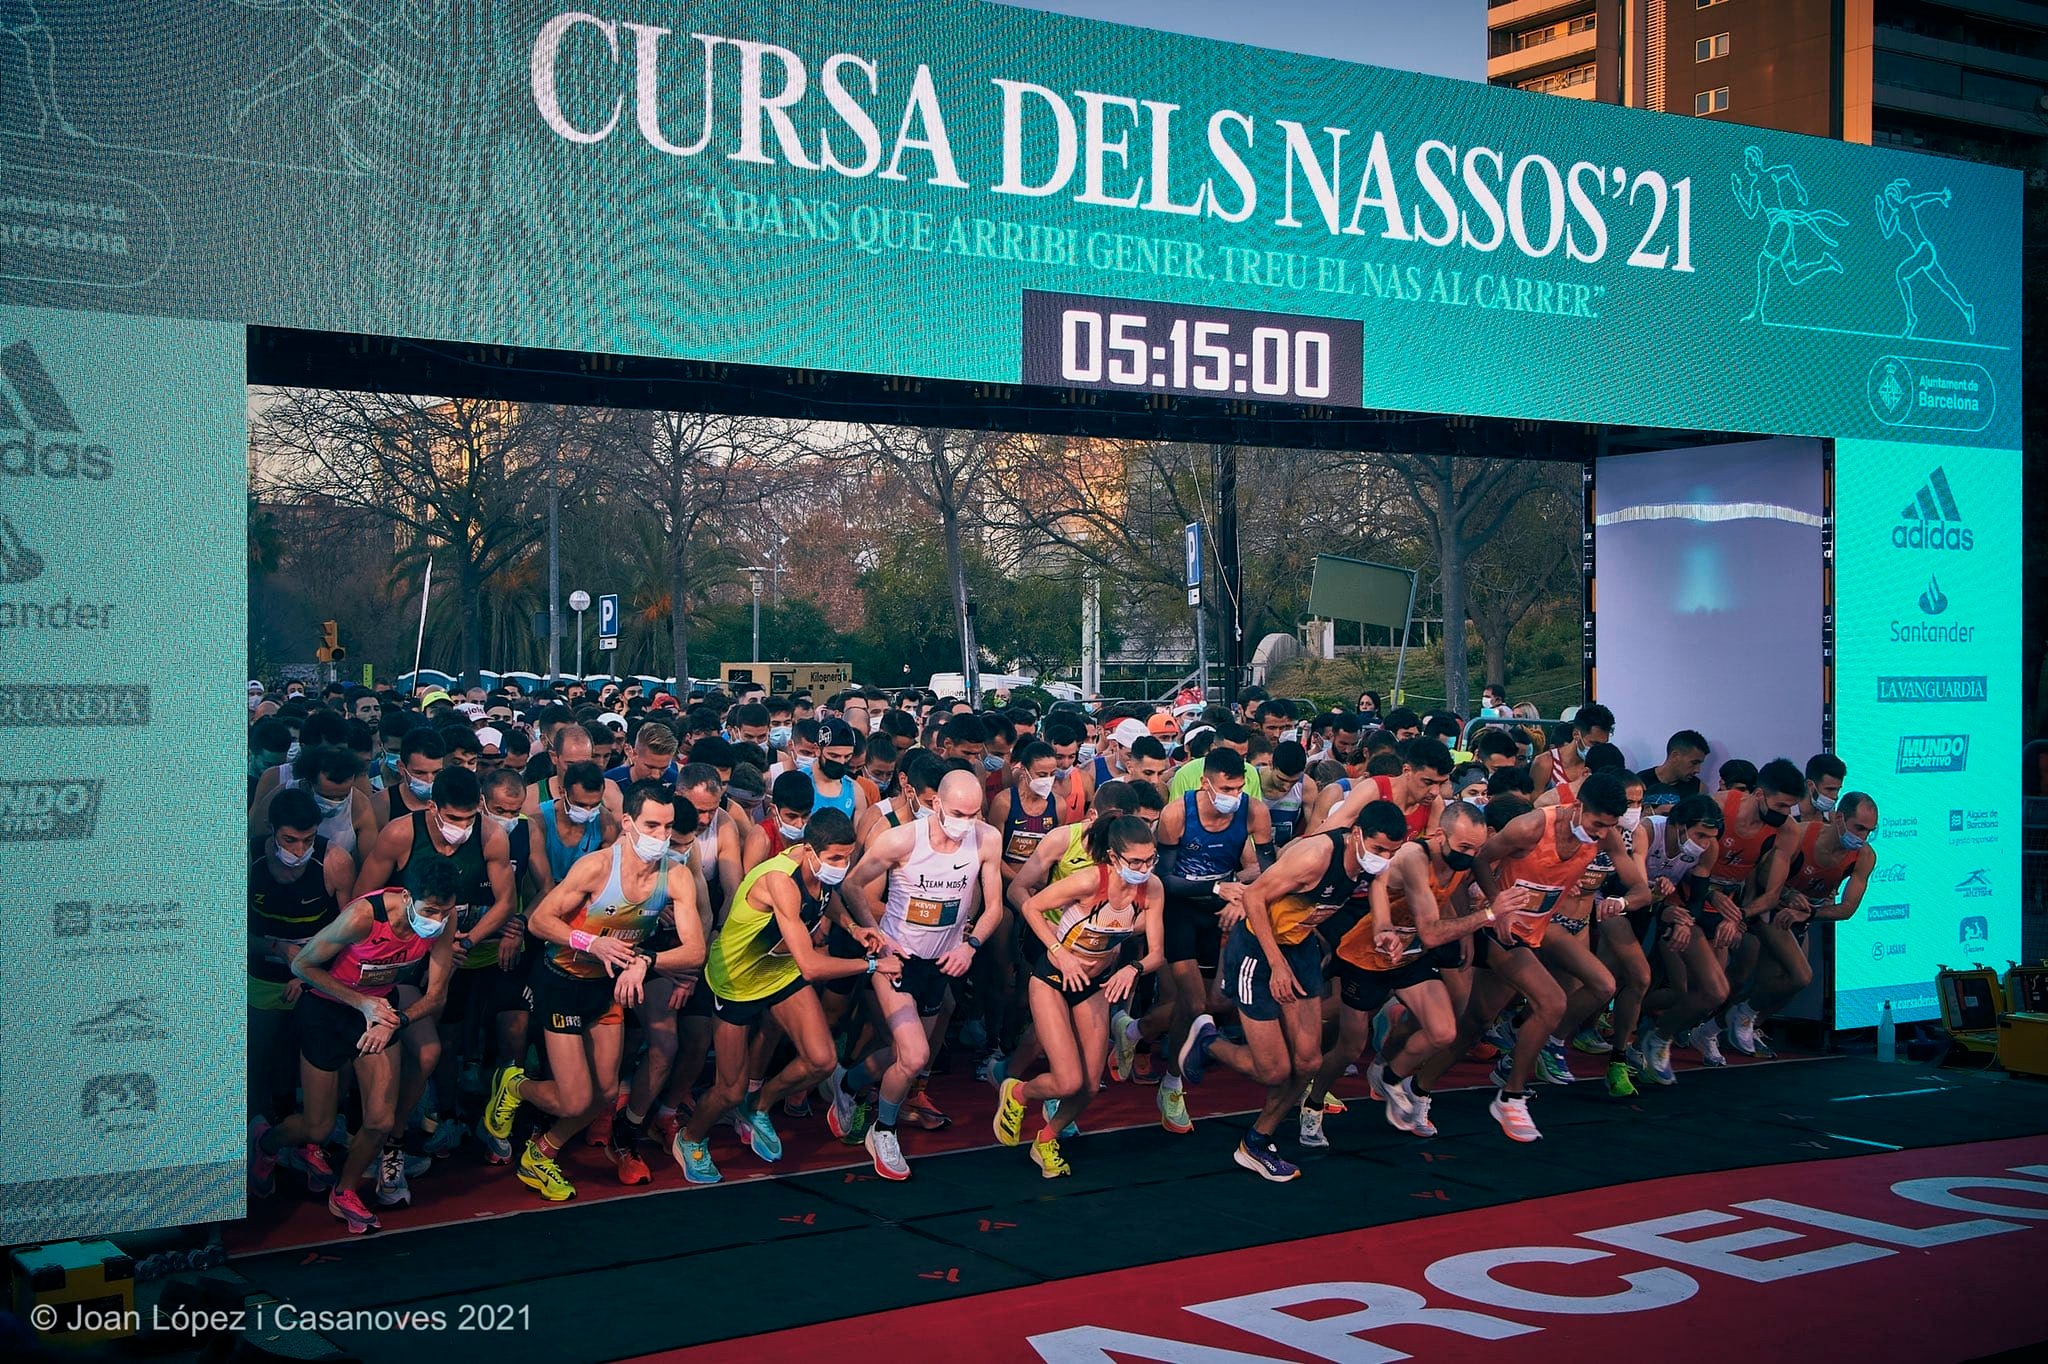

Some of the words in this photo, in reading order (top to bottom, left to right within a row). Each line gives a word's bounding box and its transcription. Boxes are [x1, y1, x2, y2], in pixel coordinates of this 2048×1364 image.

[532, 12, 969, 189] CURSA
[992, 78, 1258, 223] DELS
[851, 204, 935, 256] QUE
[944, 223, 1076, 267] ARRIBI
[1088, 231, 1215, 282] GENER,
[1218, 246, 1308, 293] TREU
[1316, 258, 1354, 295] EL
[1362, 262, 1422, 304] NAS
[1431, 271, 1468, 309] AL
[1061, 309, 1330, 399] 05:15:00
[1919, 375, 1966, 389] Ajuntament
[1967, 380, 1979, 391] de
[1919, 391, 1979, 411] Barcelona
[1892, 521, 1974, 551] adidas
[1187, 532, 1196, 578] P
[602, 599, 614, 632] P
[1890, 621, 1975, 643] Santander
[1880, 681, 1898, 698] LA
[1899, 680, 1985, 698] VANGUARDIA
[1902, 737, 1964, 757] MUNDO
[1902, 757, 1951, 768] DEPORTIVO
[1882, 829, 1917, 838] Barcelona
[925, 880, 943, 889] TEAM
[919, 910, 930, 918] 13
